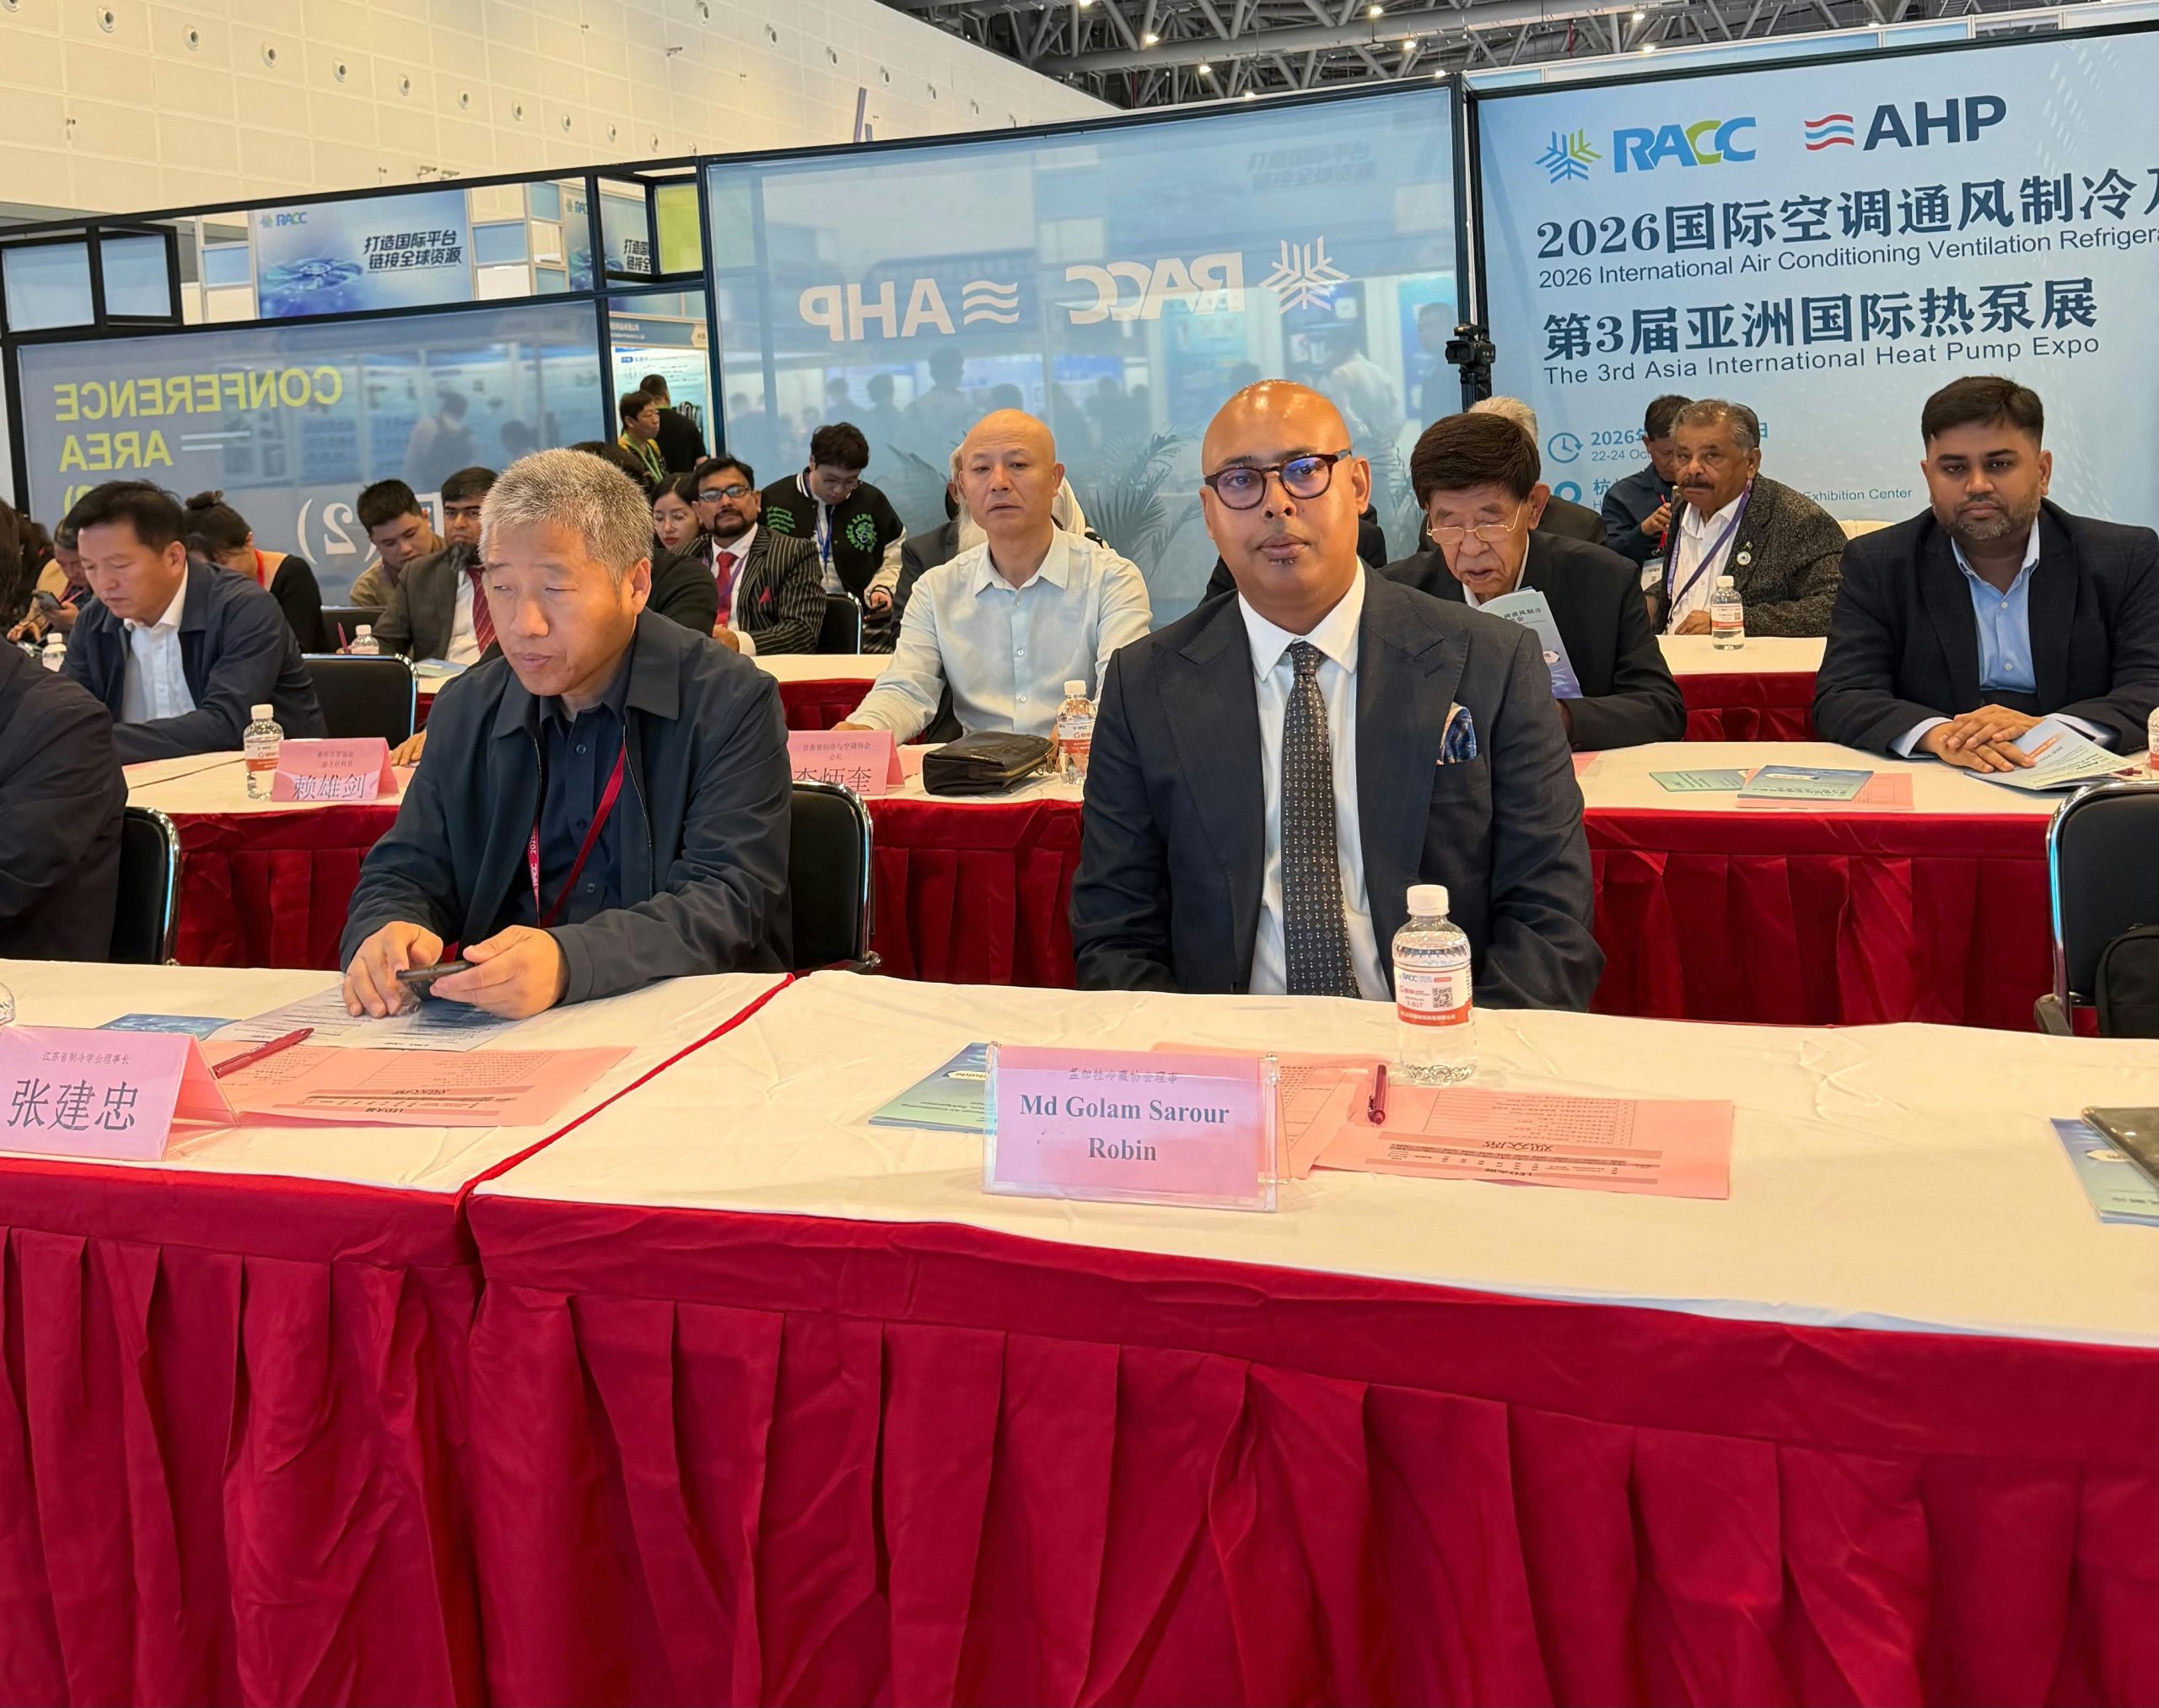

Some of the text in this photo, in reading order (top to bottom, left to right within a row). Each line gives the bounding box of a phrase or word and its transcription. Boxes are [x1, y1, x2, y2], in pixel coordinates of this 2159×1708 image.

[1862, 94, 2007, 151] AHP
[1613, 117, 1757, 173] RACC
[276, 212, 308, 227] RACC
[1537, 168, 2159, 258] 2026国际空调通风制冷
[363, 229, 457, 255] 打造国际平台
[368, 246, 463, 270] 链接全球资源
[1539, 267, 1592, 288] 2026
[1600, 256, 1733, 284] International
[1740, 253, 1772, 273] Air
[1778, 244, 1920, 271] Conditioning
[1927, 234, 2051, 259] Ventilation
[1543, 277, 2097, 362] 第3届亚洲国际热泵展
[1543, 337, 2099, 385] The 3rd Asia International Heat Pump Expo
[1591, 450, 1625, 461] 22-24
[1869, 488, 1913, 499] Center
[293, 773, 367, 800] 赖雄剑
[7, 1077, 139, 1131] 张建忠
[1019, 1095, 1230, 1123] Md Golam Sarour
[1088, 1137, 1157, 1161] Robin
